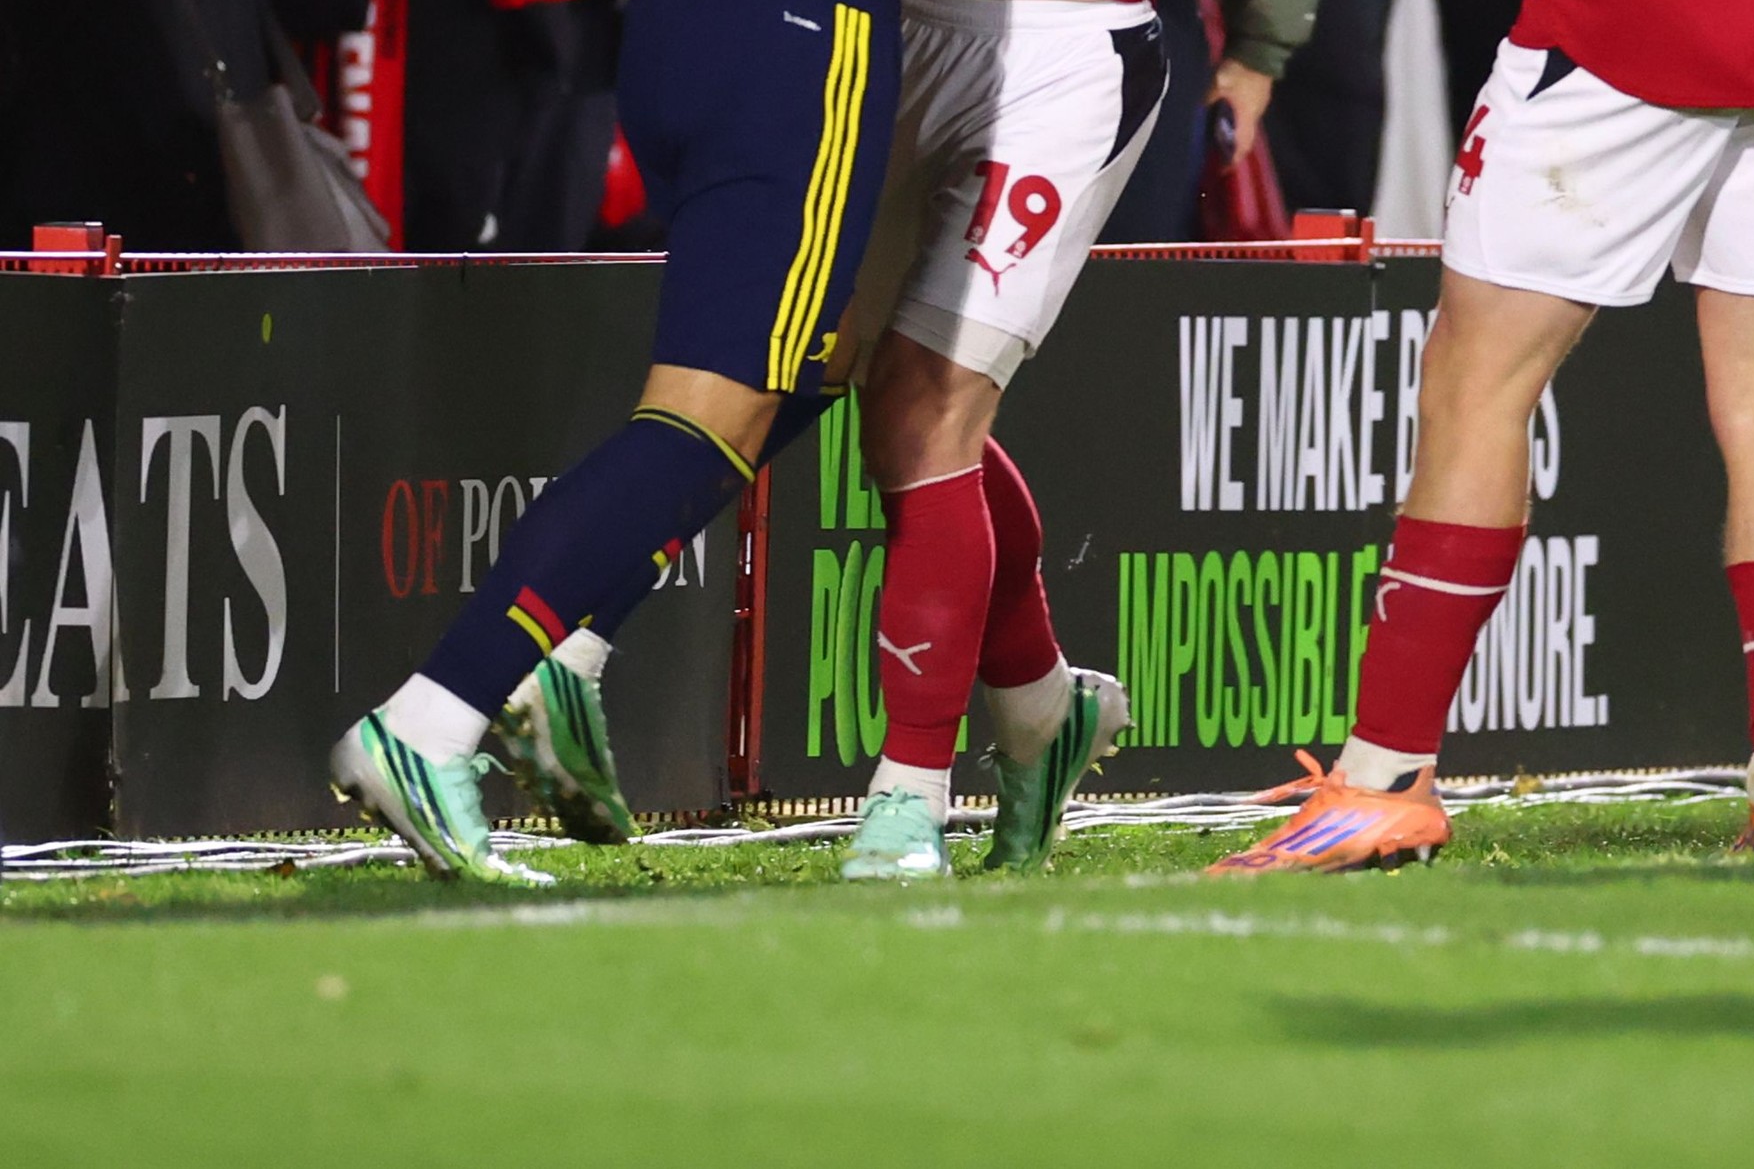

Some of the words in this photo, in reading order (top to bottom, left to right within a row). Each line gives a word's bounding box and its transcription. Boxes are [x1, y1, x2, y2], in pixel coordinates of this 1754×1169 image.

[964, 160, 1062, 259] 19
[1180, 316, 1248, 511] WE
[1257, 310, 1390, 511] MAKE
[382, 479, 449, 598] OF
[1117, 544, 1378, 748] IMPOSSIBLE
